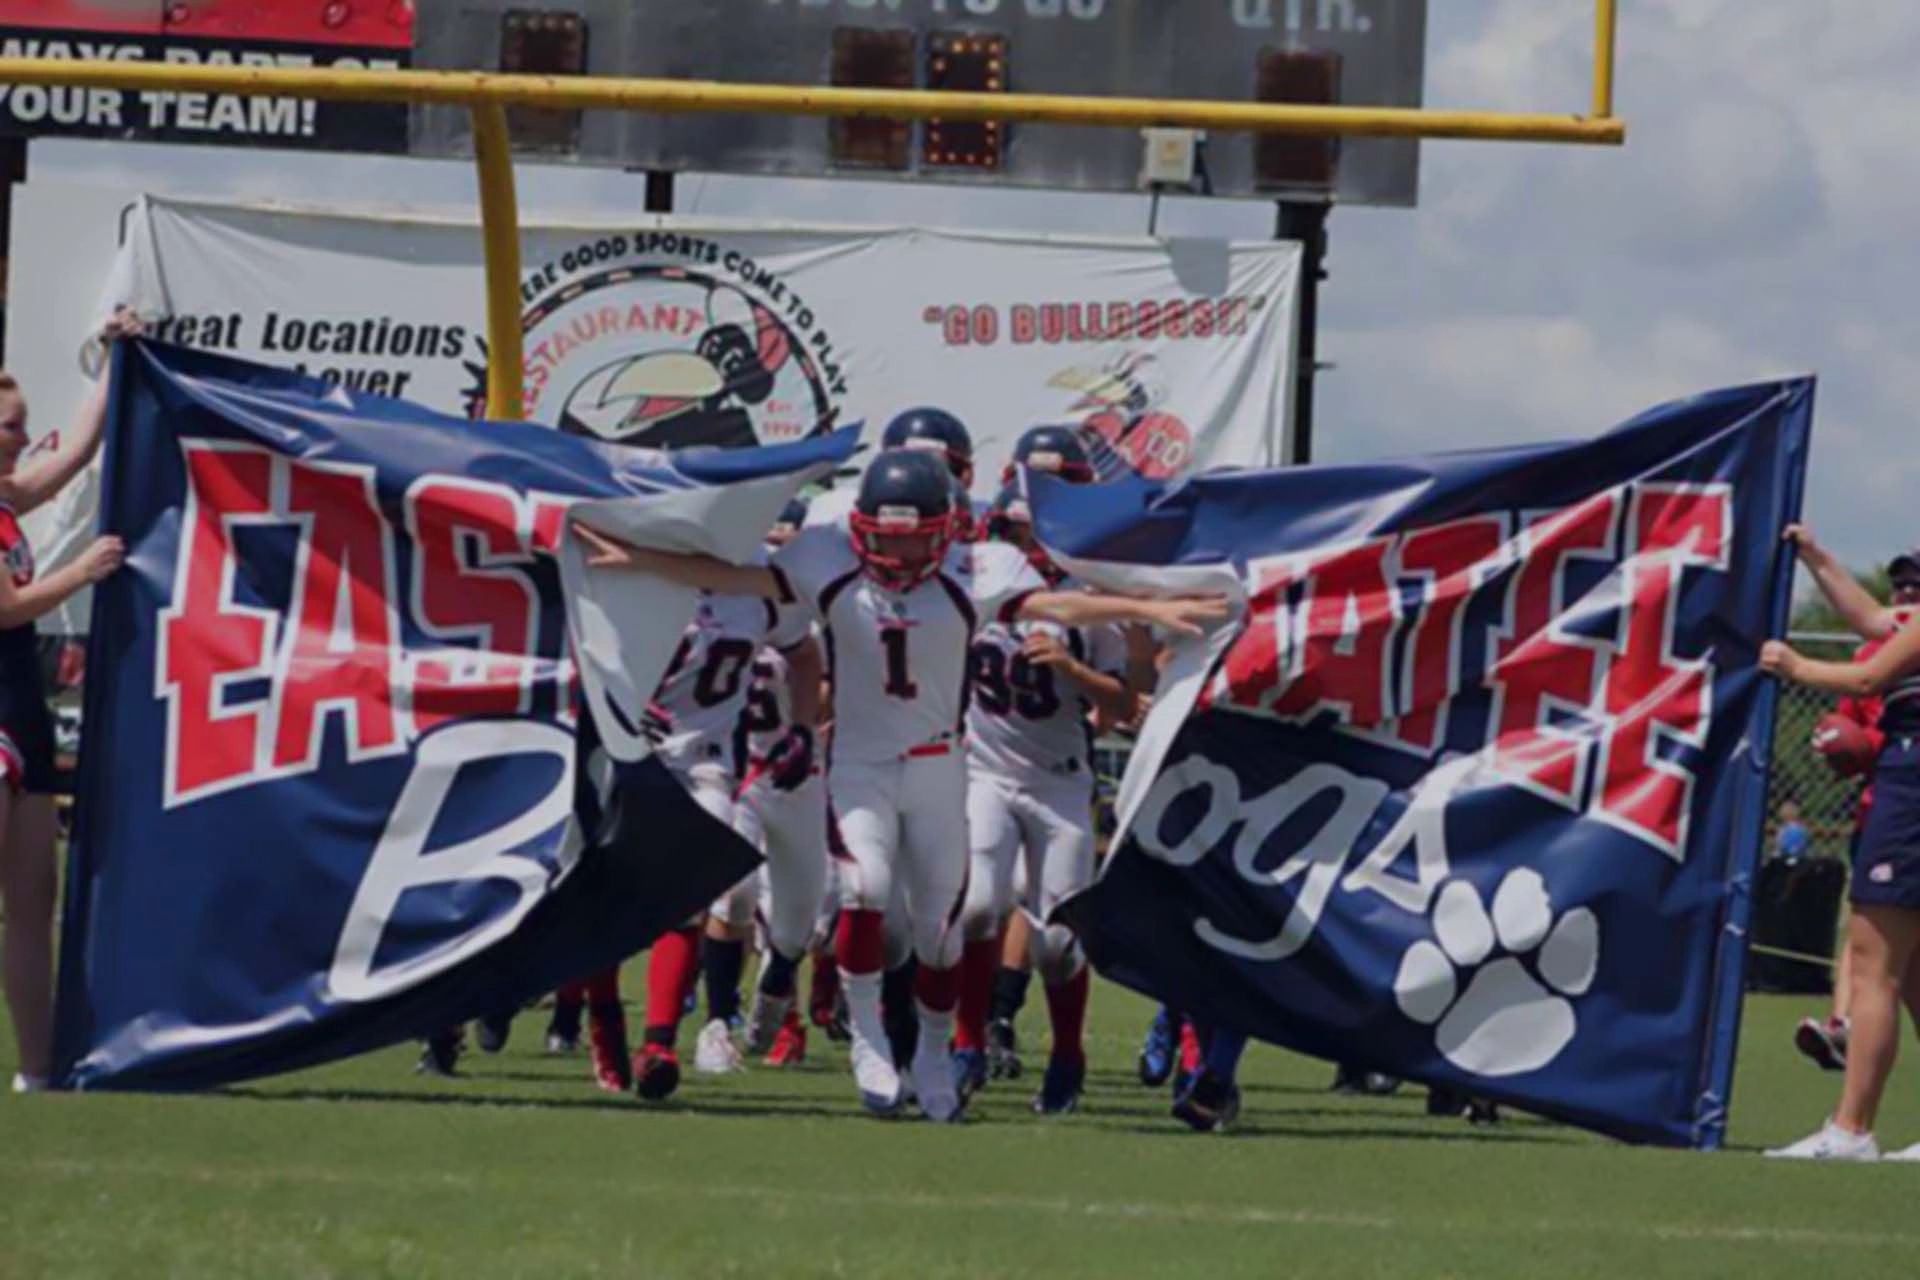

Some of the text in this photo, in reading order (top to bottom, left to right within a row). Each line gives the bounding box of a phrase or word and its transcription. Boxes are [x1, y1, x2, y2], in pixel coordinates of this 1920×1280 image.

[139, 90, 317, 136] TEAM!
[156, 312, 466, 358] reat Locations
[561, 235, 627, 272] GOOD
[634, 231, 719, 263] SPORTS
[723, 251, 787, 303] COME
[787, 293, 814, 330] TO
[811, 330, 848, 394] PLAY
[522, 302, 705, 420] ESTAURANT
[881, 626, 917, 700] 1
